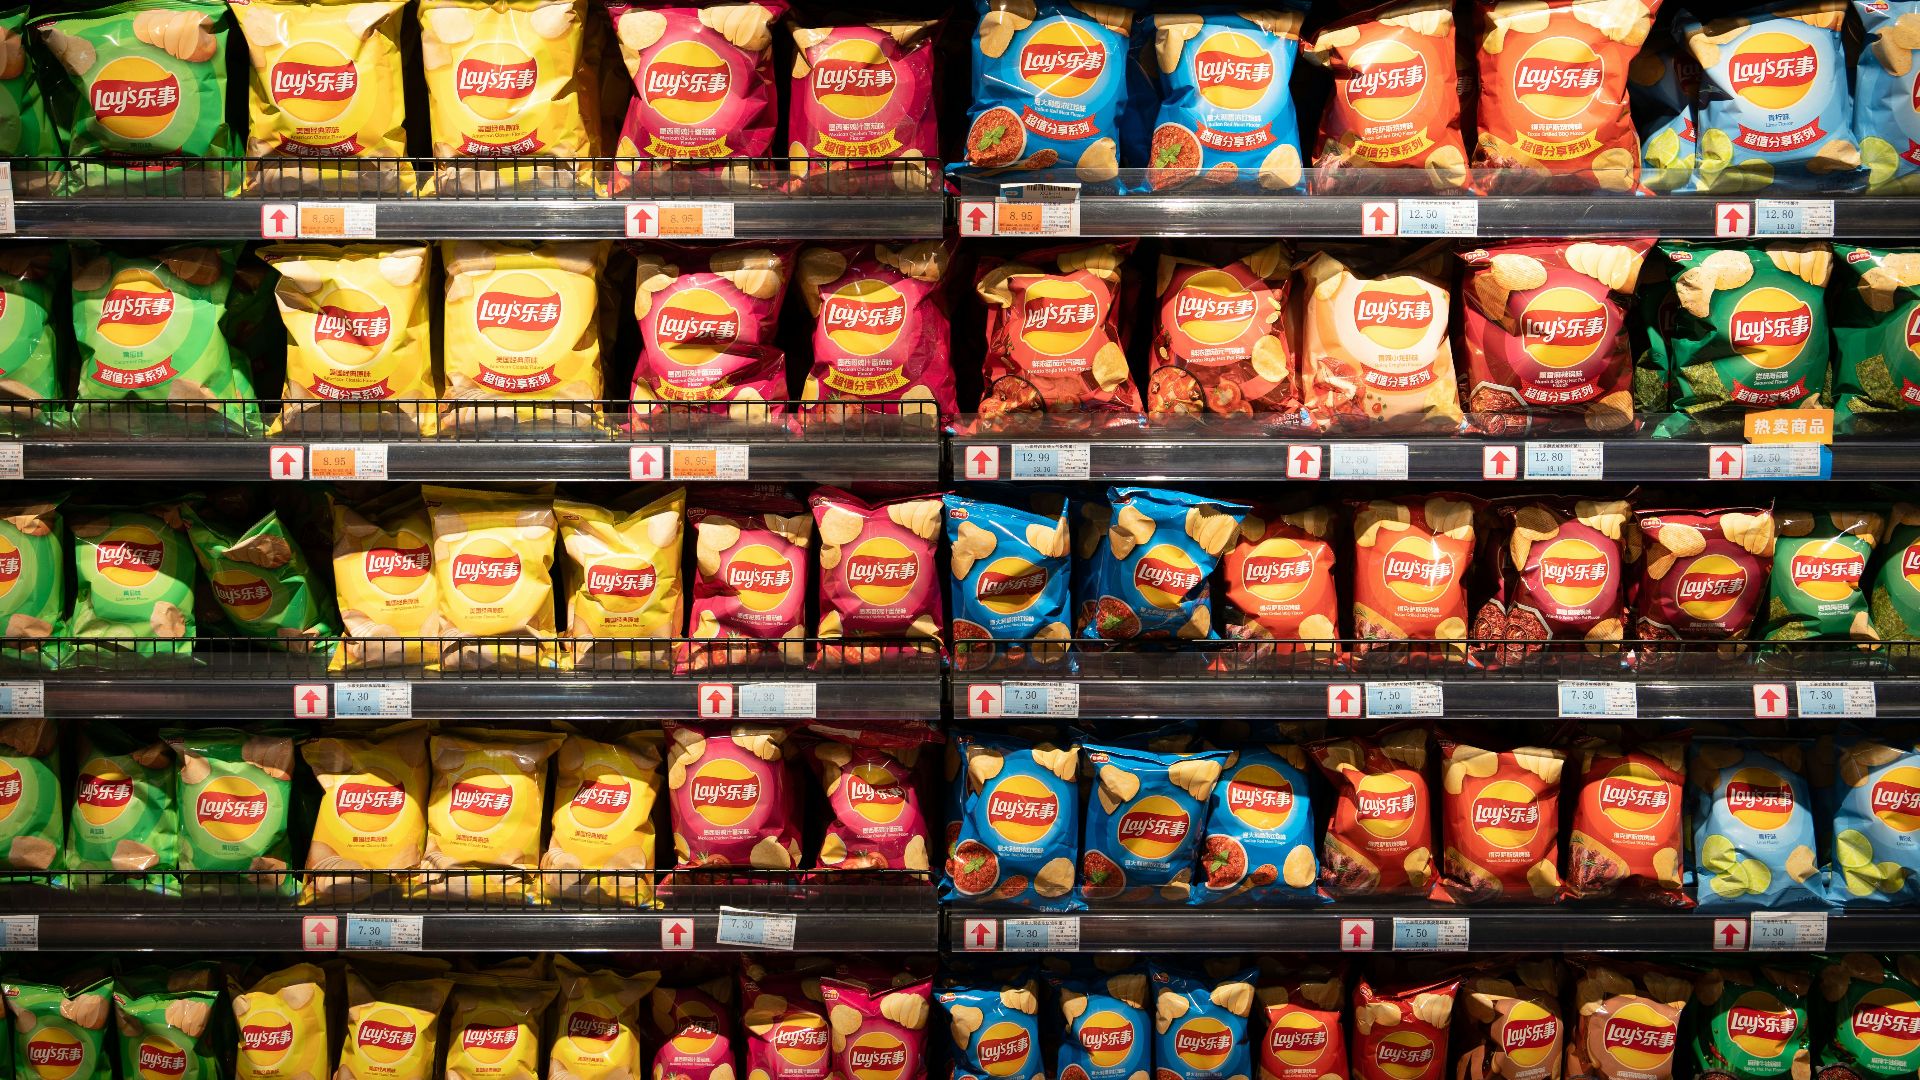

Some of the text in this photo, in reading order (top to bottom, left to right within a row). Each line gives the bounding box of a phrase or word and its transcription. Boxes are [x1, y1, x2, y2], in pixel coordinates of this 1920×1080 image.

[1024, 112, 1090, 137] 超值分享系列
[1200, 130, 1268, 148] 超值分享系列
[1744, 126, 1816, 148] 超值分享系列
[1520, 138, 1591, 158] 超值分享系列
[1409, 209, 1438, 219] 12.50
[1766, 210, 1794, 219] 12.80
[100, 366, 168, 386] 超值分享系列
[482, 372, 551, 390] 超值分享系列
[1365, 370, 1431, 388] 超值分享系列
[1524, 384, 1594, 402] 超值分享系列
[1754, 418, 1825, 435] 热卖商品
[1022, 452, 1050, 462] 12.99
[1535, 452, 1563, 462] 12.80
[1753, 453, 1780, 462] 12.50
[347, 692, 368, 701] 7.30
[1015, 691, 1036, 699] 7.30
[1572, 690, 1594, 700] 7.30
[1810, 691, 1832, 699] 7.30
[732, 920, 754, 929] 7.30
[359, 926, 380, 935] 7.30
[1016, 930, 1038, 938] 7.30
[1406, 929, 1428, 937] 7.50
[1762, 928, 1784, 936] 7.30
